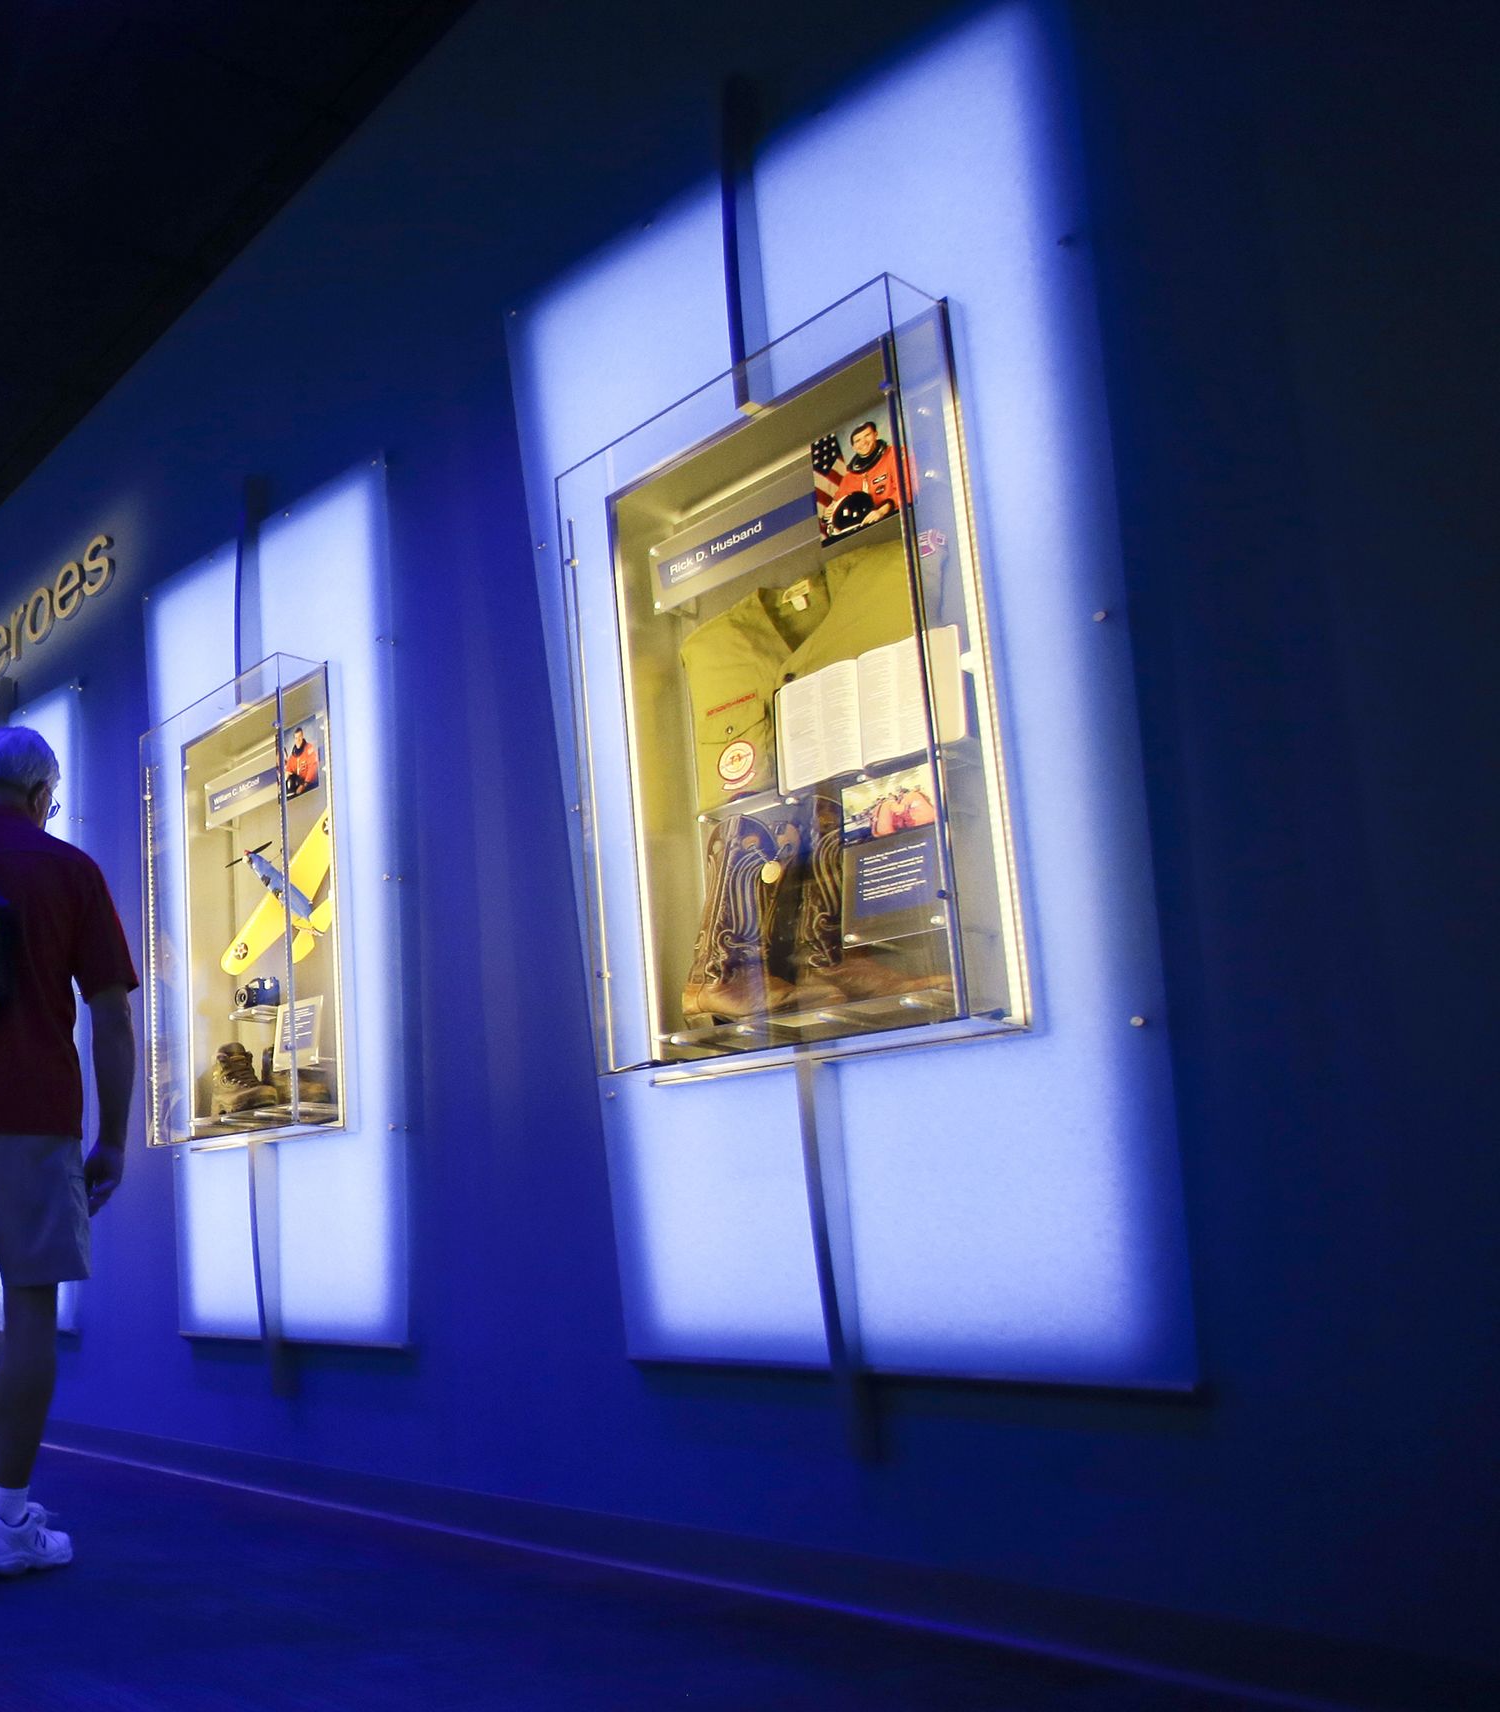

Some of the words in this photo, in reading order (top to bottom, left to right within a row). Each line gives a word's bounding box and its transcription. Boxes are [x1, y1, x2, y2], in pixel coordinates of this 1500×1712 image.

[669, 557, 694, 576] Rick
[695, 550, 708, 563] D.
[710, 520, 763, 556] Husband
